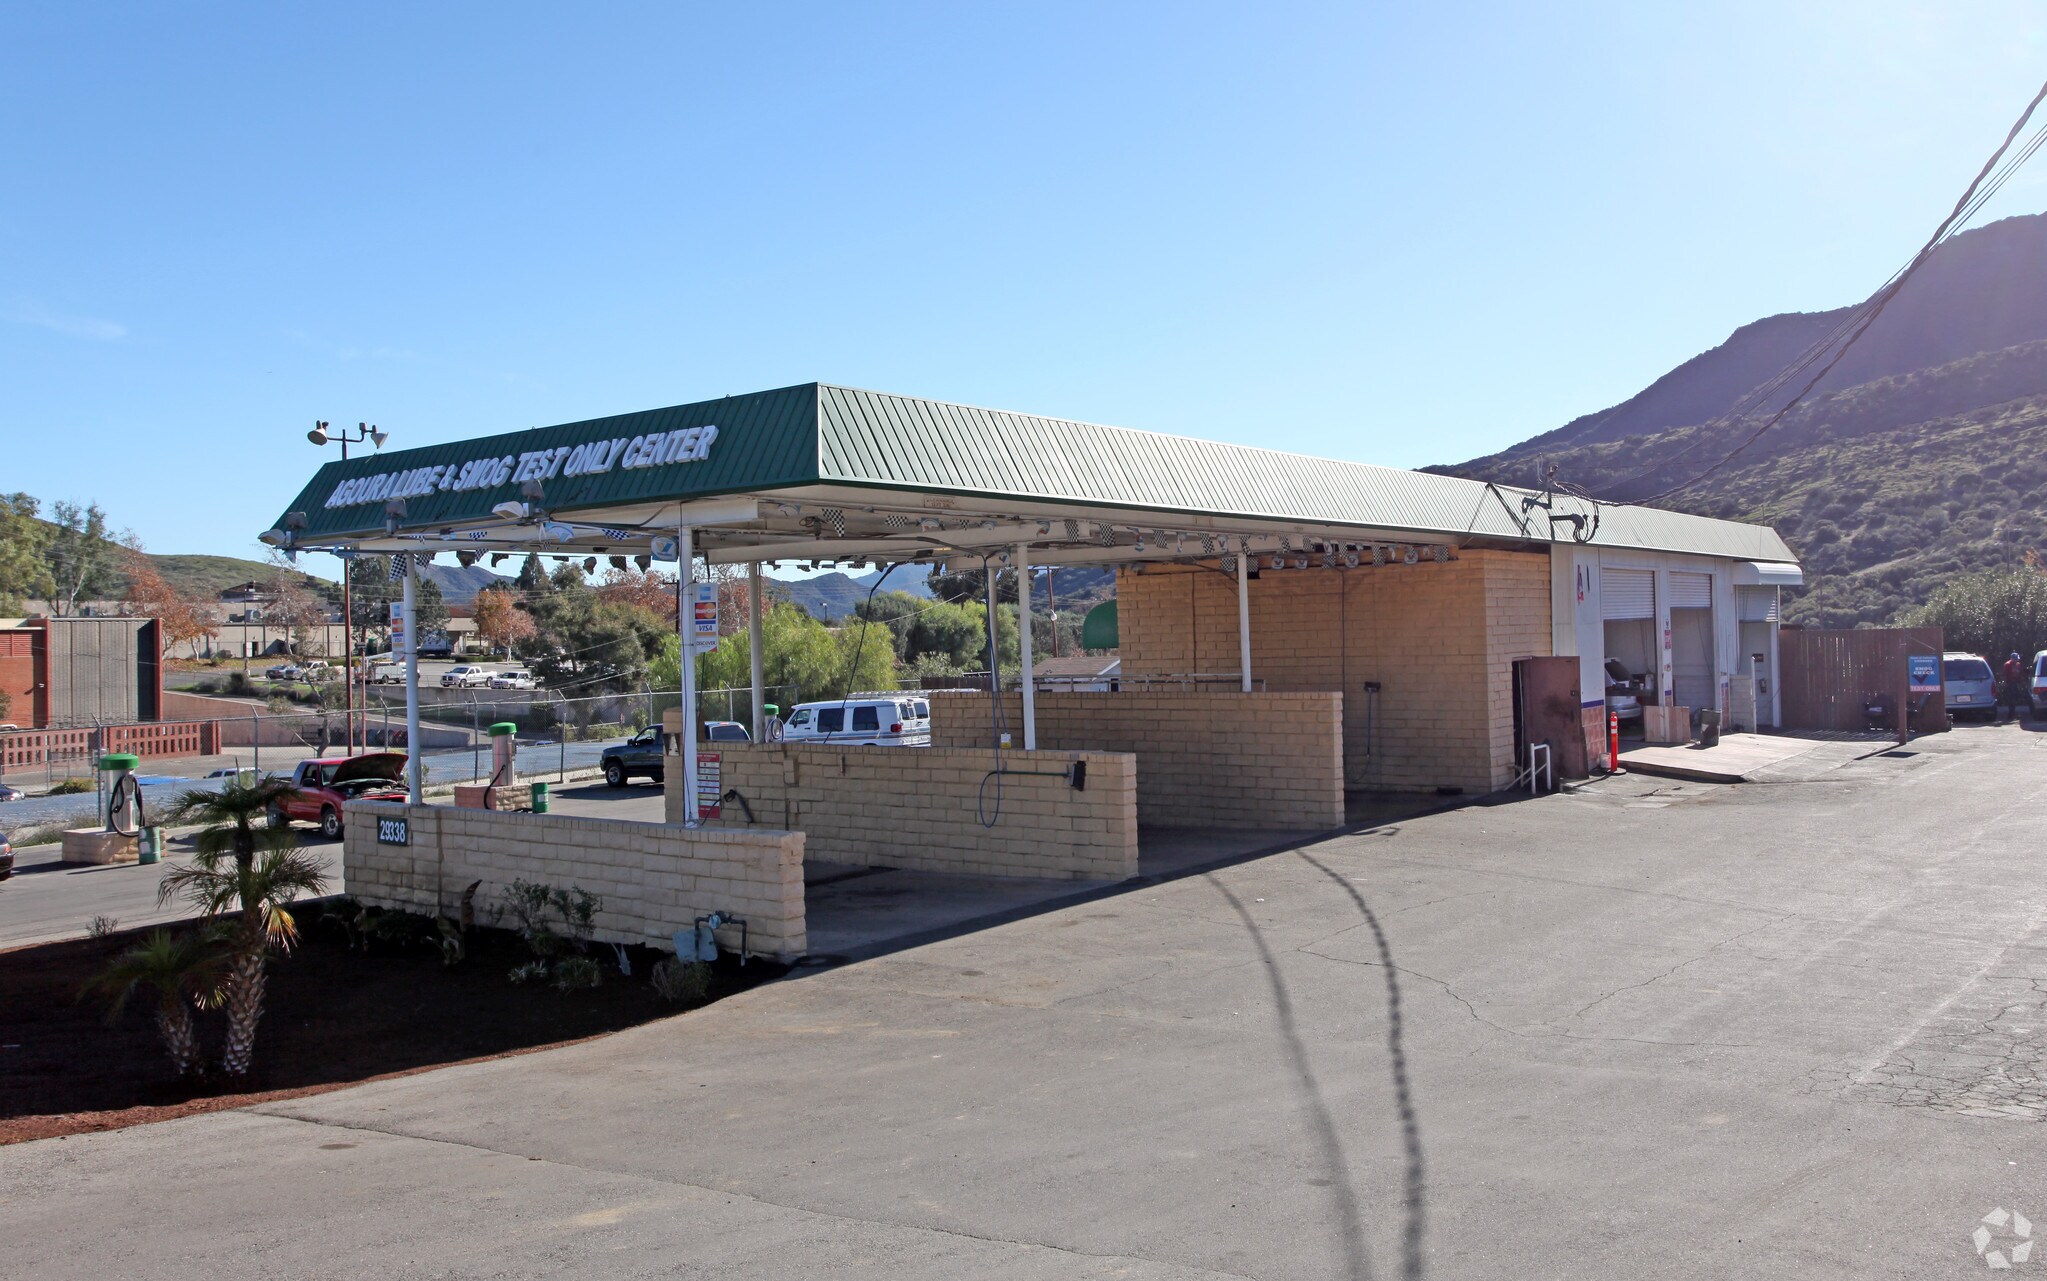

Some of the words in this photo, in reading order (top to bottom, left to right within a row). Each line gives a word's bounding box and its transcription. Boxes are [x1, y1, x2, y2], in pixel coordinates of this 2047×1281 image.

[324, 471, 399, 509] AGOURA
[390, 465, 446, 500] LUBE
[438, 463, 458, 492] &
[452, 454, 515, 492] SMOG
[511, 446, 572, 484] TEST
[564, 437, 629, 478] ONLY
[621, 424, 719, 470] CENTER
[380, 820, 406, 842] 29338
